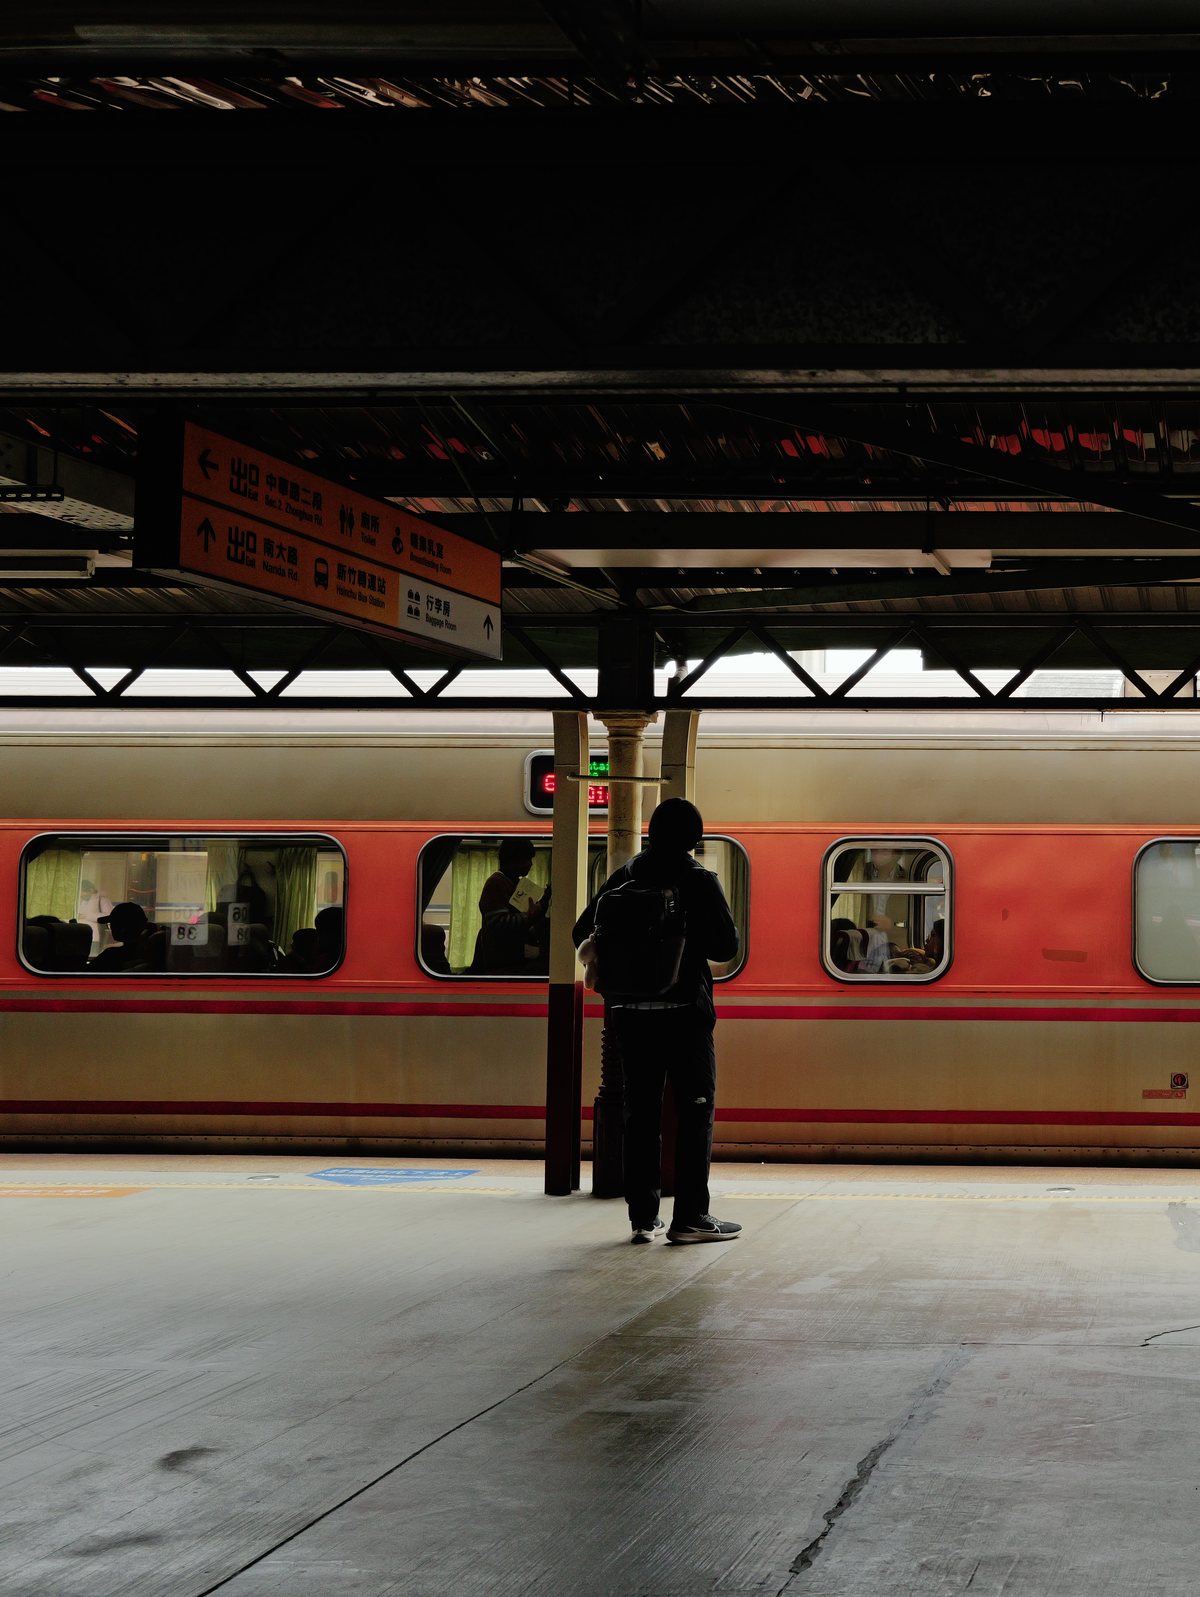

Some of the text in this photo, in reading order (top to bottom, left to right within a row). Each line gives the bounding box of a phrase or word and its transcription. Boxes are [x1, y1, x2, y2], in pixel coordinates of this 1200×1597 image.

[229, 457, 260, 498] 出口
[265, 472, 323, 512] 中華路二段
[226, 525, 257, 565] 出口
[361, 531, 377, 547] Toilet
[245, 555, 256, 569] Exit
[263, 537, 298, 566] 南大路
[262, 560, 286, 578] Nanda
[336, 584, 386, 609] Hsinchu Bus Station
[426, 594, 451, 617] 行李房
[425, 612, 457, 632] Baggage Room
